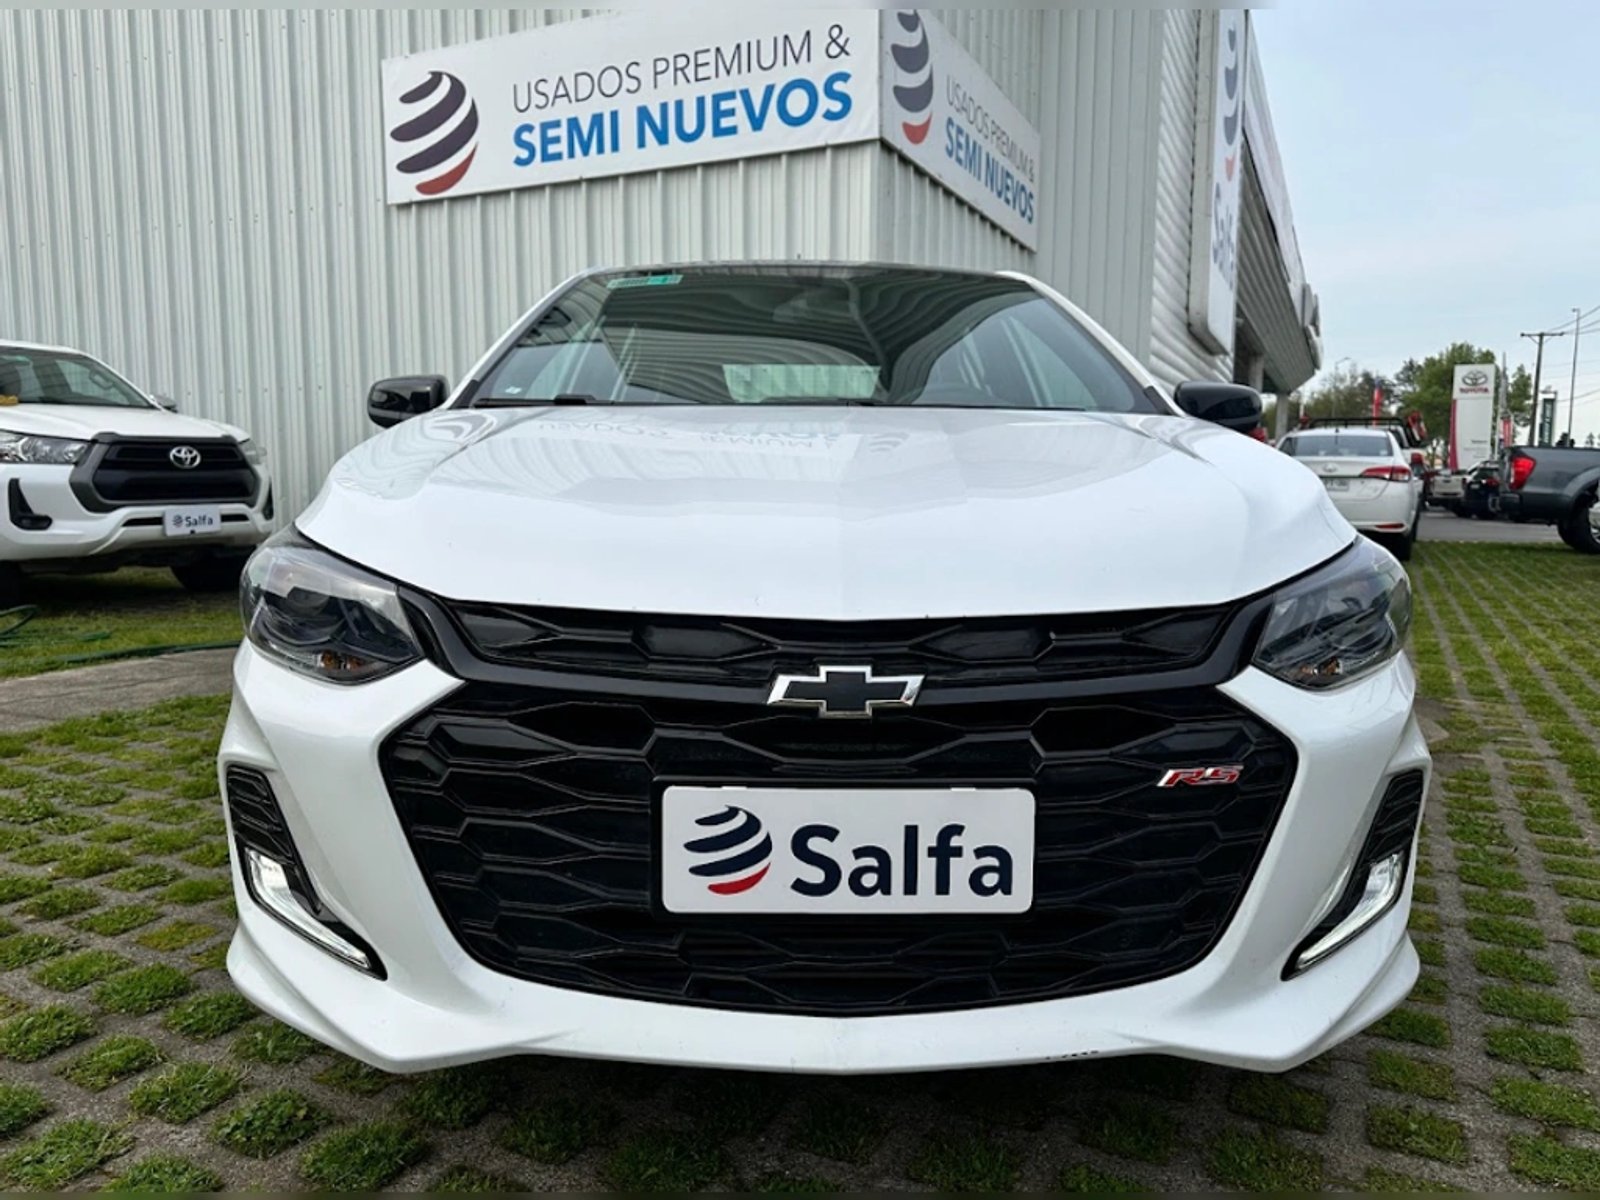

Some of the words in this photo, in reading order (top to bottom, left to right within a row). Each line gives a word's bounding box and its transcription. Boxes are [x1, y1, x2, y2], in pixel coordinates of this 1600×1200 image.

[513, 60, 642, 113] USADOS
[653, 30, 813, 90] PREMIUM
[826, 23, 852, 59] &
[512, 110, 620, 167] SEMI
[636, 72, 853, 149] NUEVOS
[946, 74, 989, 140] USADOS
[945, 116, 983, 182] SEMI
[984, 151, 1035, 225] NUEVOS
[185, 514, 214, 528] Salfa
[1156, 764, 1245, 788] RS
[790, 823, 1013, 899] Salfa
